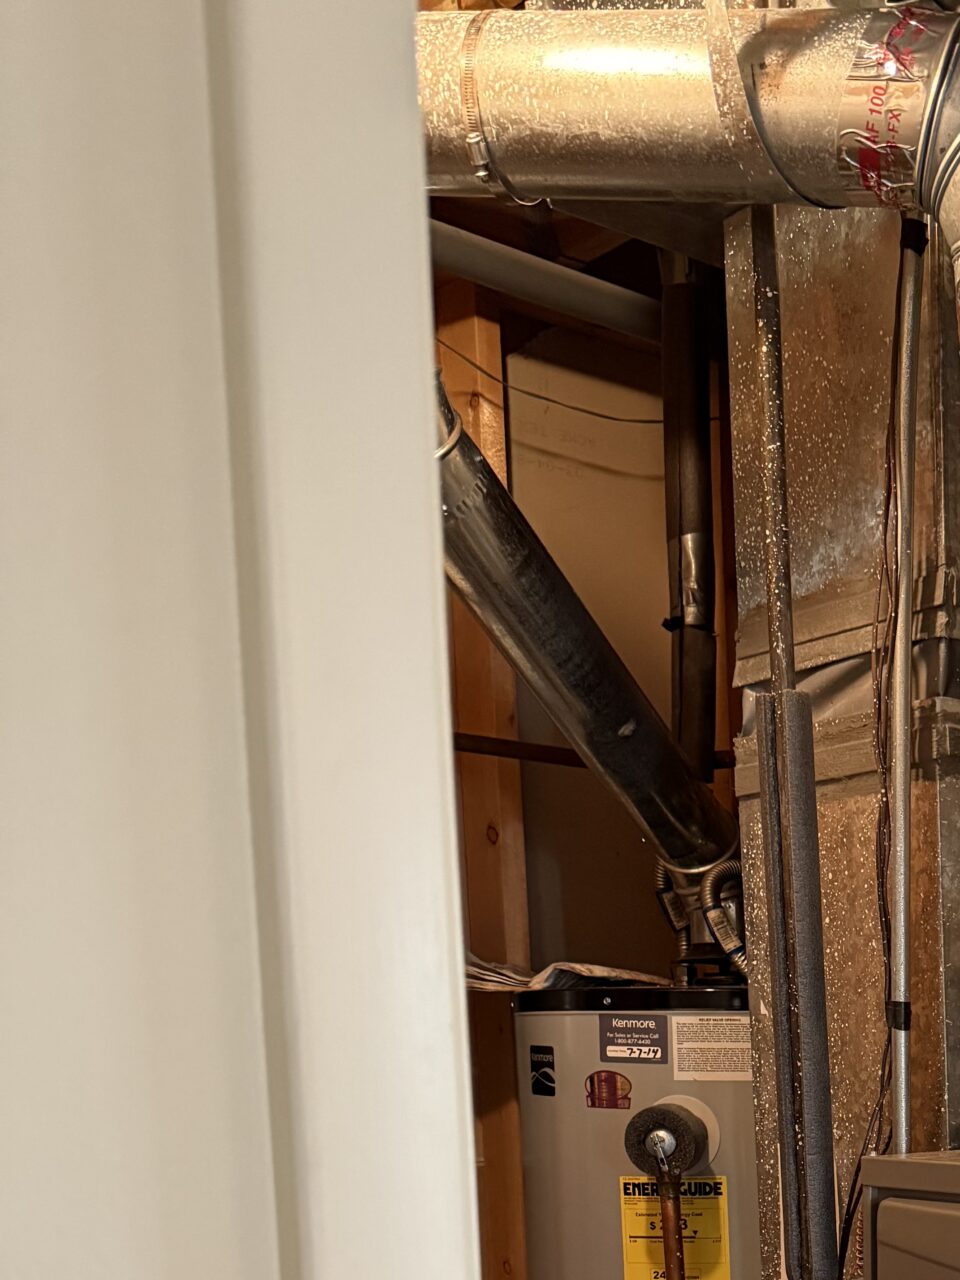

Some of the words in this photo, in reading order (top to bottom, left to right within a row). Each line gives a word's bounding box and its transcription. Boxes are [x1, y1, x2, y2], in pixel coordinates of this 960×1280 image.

[868, 84, 887, 116] 100
[612, 1018, 656, 1028] Kenmore
[623, 1181, 723, 1197] ENERGUIDE
